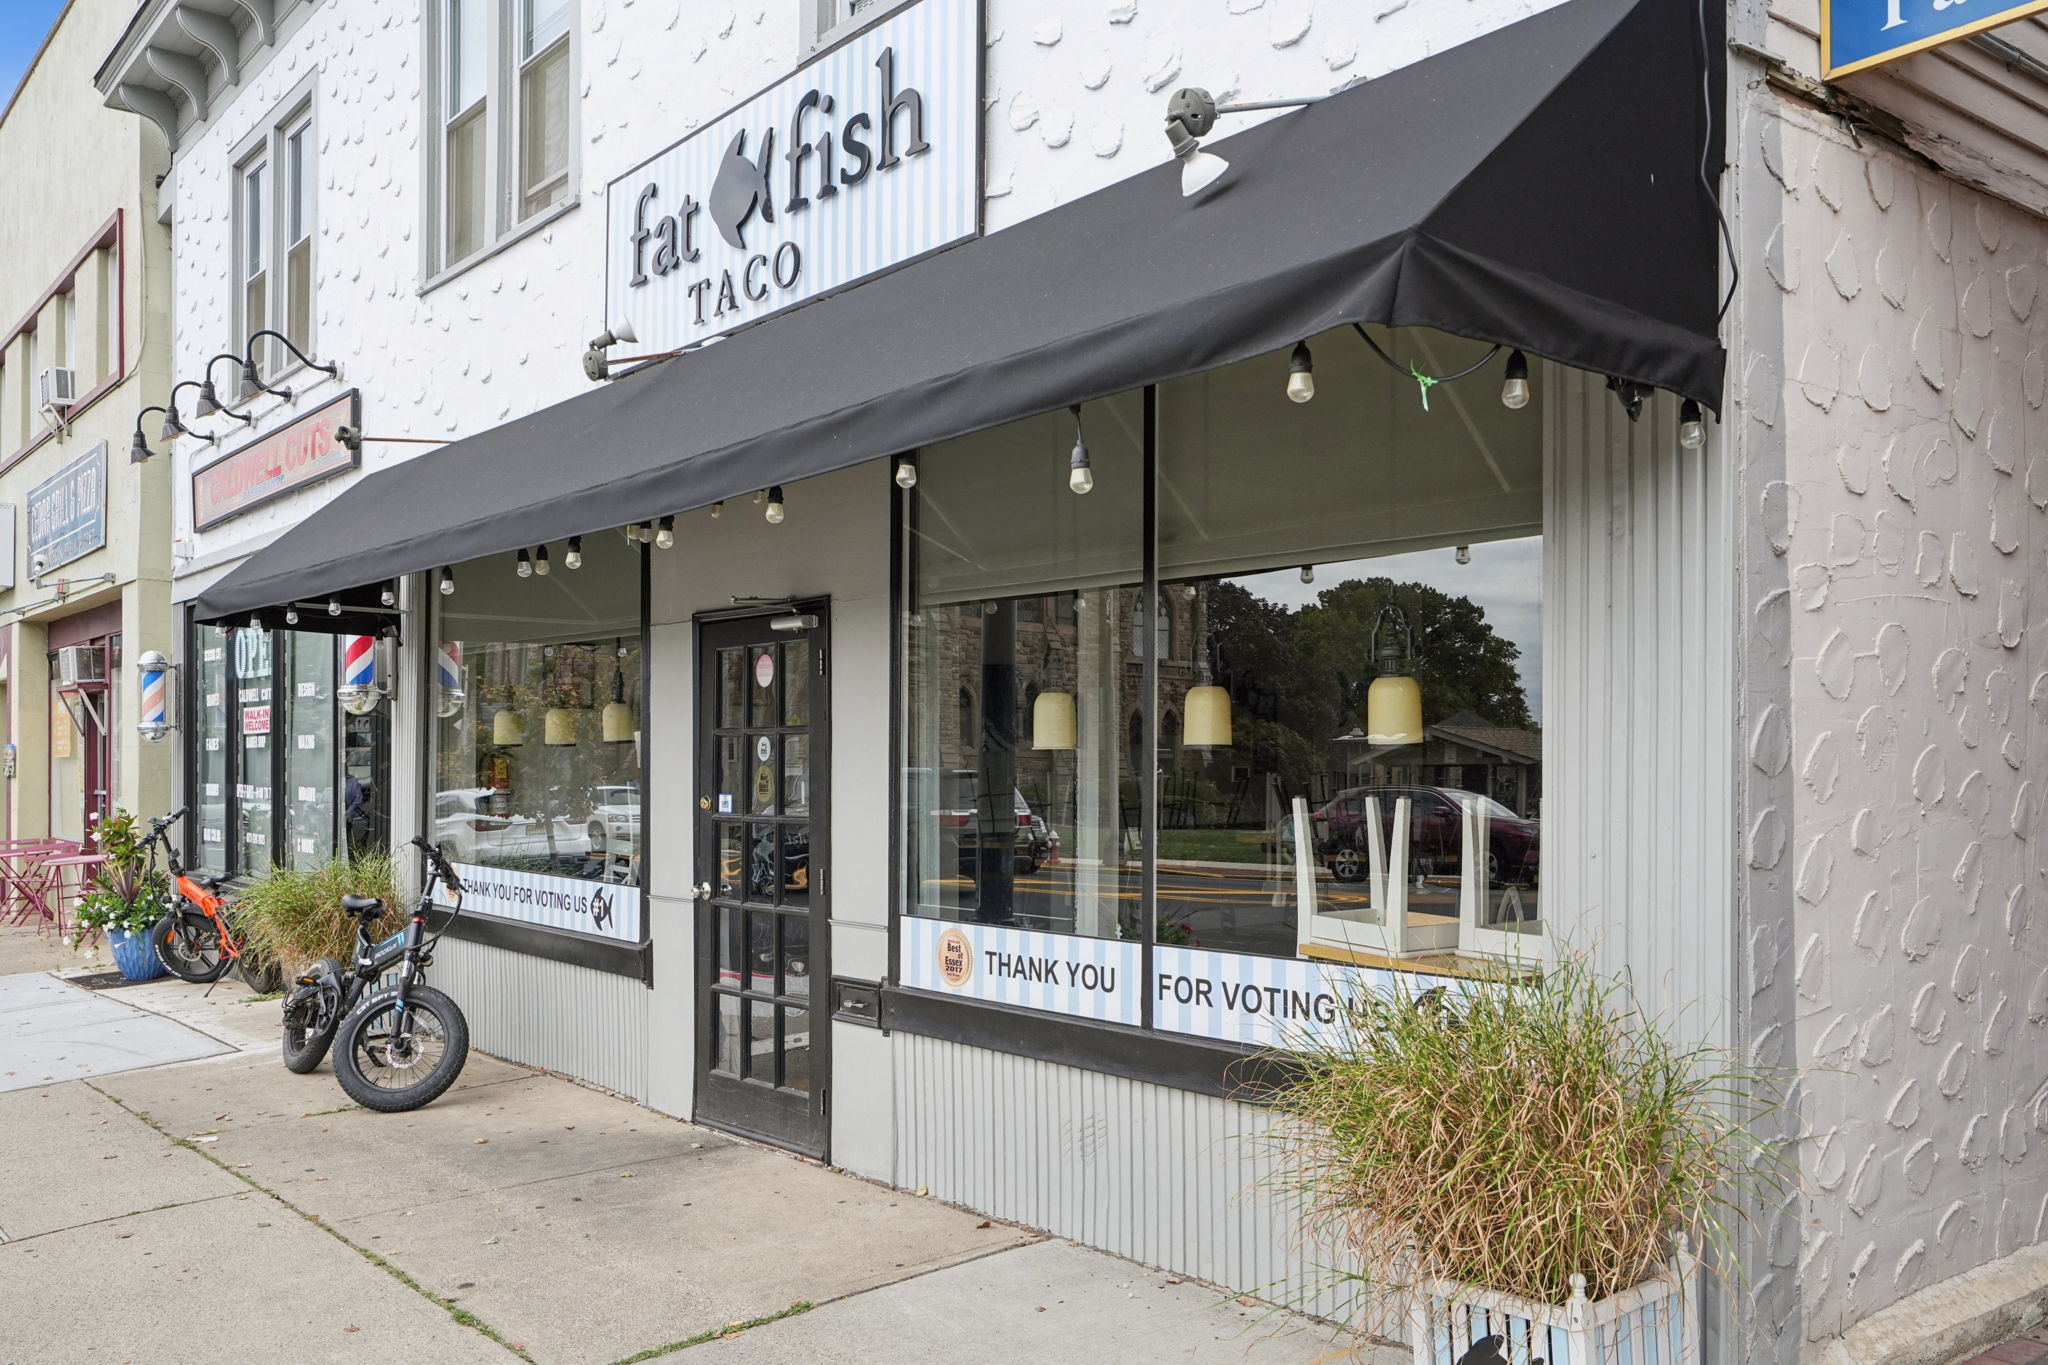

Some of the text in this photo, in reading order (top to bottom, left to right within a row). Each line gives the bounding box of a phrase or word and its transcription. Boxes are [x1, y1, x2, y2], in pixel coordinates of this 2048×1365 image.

[629, 46, 932, 288] fat fish
[688, 240, 801, 326] TACO
[209, 417, 331, 505] CALDWELL CUTS
[31, 496, 51, 543] CEDAR
[51, 484, 69, 532] GRILL
[77, 466, 97, 517] PIZZA
[235, 627, 272, 679] OPE
[244, 707, 270, 720] WALK-IN
[244, 719, 270, 731] WELCOME
[462, 877, 491, 899] THANK
[493, 883, 512, 900] YOU
[514, 886, 533, 905] FOR
[535, 889, 571, 911] VOTING
[574, 896, 588, 914] US
[945, 955, 963, 967] Essex
[947, 942, 961, 954] Best
[957, 952, 964, 960] of
[945, 965, 963, 973] 2017
[984, 950, 1116, 994] THANK YOU
[1158, 972, 1214, 1008] FOR
[1221, 980, 1337, 1025] VOTING
